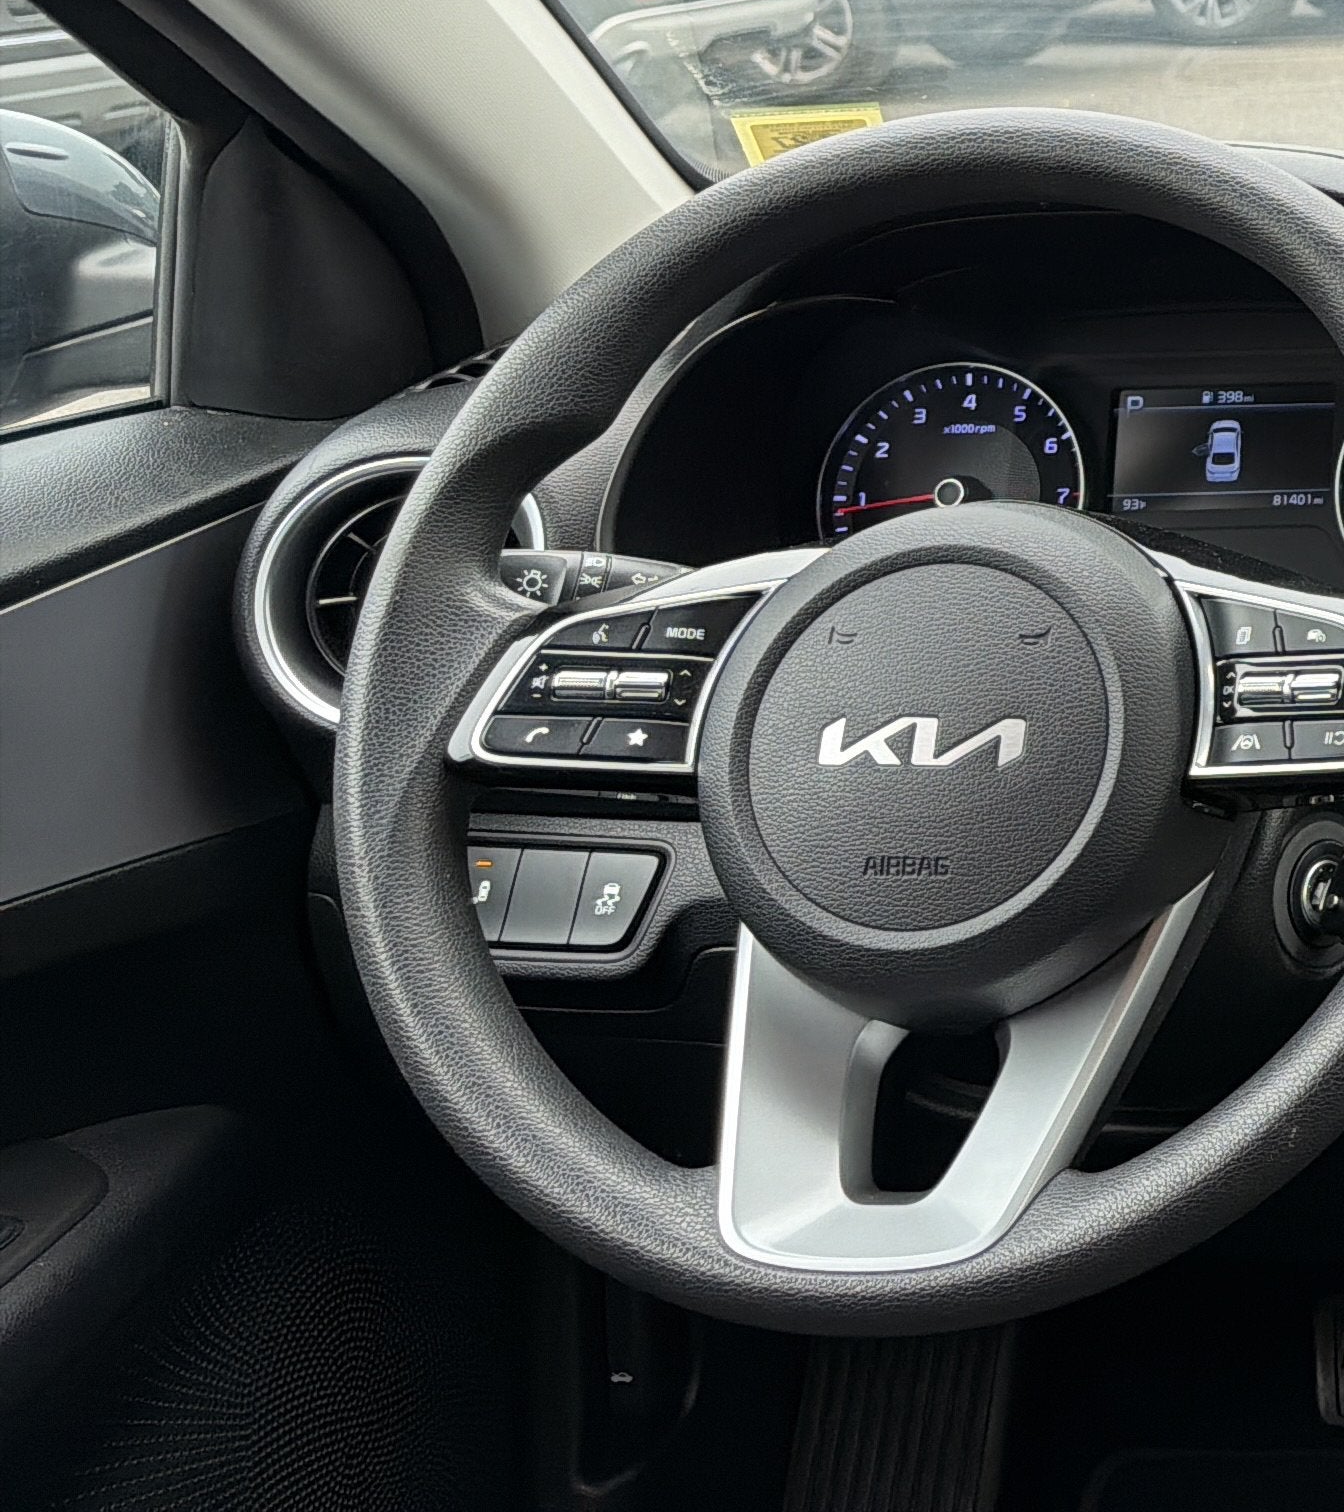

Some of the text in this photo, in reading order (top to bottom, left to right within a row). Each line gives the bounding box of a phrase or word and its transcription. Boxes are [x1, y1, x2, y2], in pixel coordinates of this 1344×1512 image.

[963, 393, 978, 411] 4
[1127, 396, 1145, 415] P
[913, 408, 928, 424] 3
[1013, 405, 1027, 422] 5
[874, 442, 890, 459] 2
[1043, 438, 1058, 454] 6
[858, 491, 867, 507] 1
[1056, 488, 1070, 505] 7
[665, 626, 706, 640] MODE
[818, 716, 1007, 767] KIA
[862, 856, 950, 877] AIRBAG
[594, 905, 617, 916] OFF
